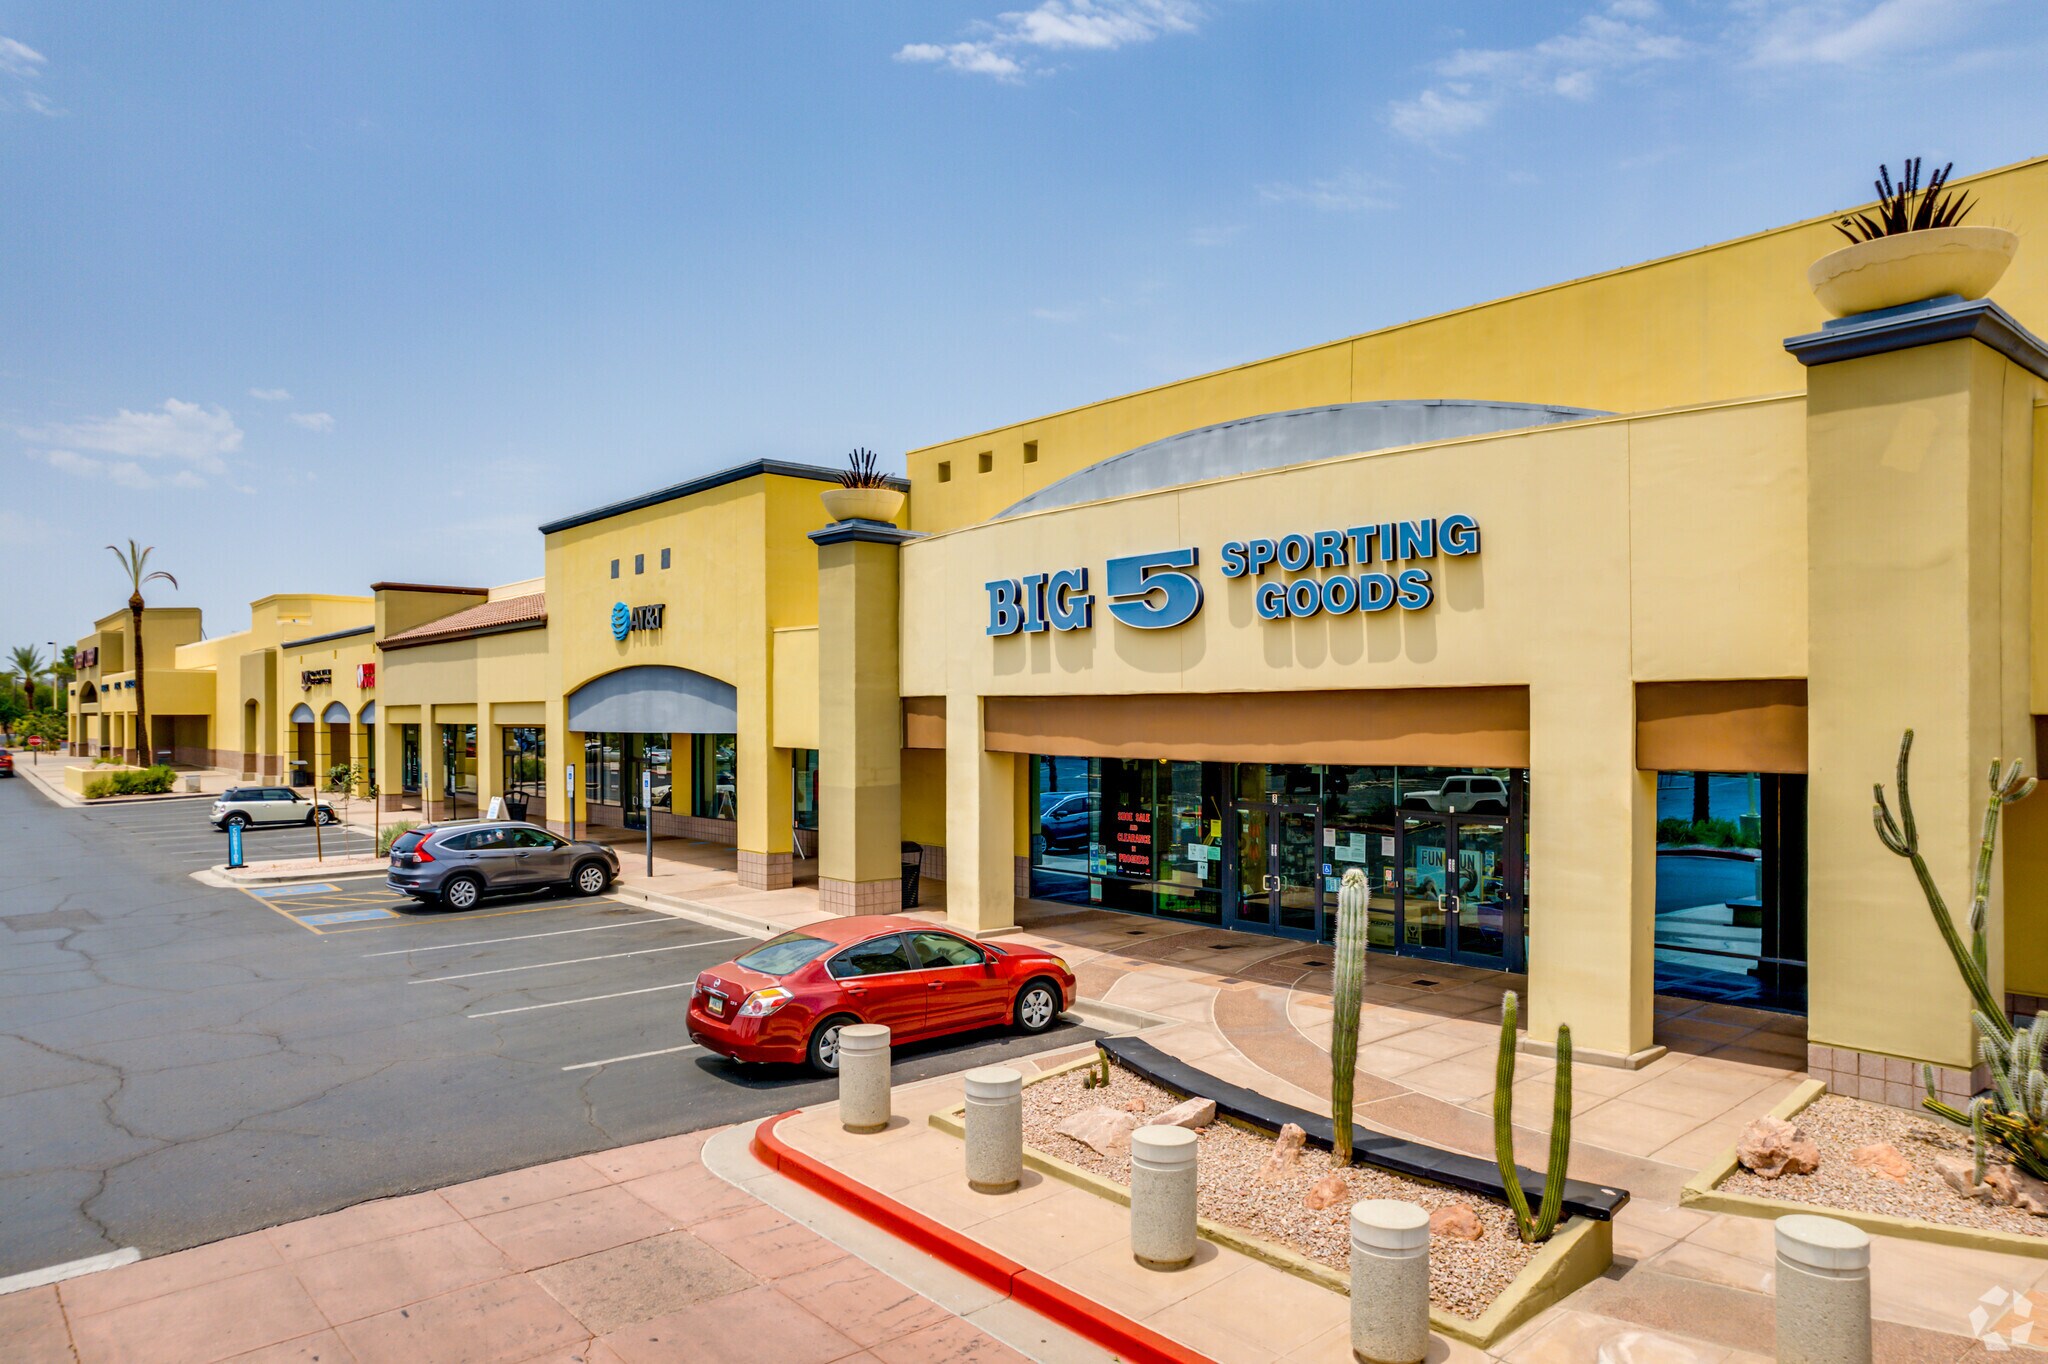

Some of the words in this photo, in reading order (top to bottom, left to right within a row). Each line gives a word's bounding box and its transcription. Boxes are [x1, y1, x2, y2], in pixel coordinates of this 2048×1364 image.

[1221, 514, 1481, 578] SPORTING
[985, 567, 1095, 636] BIG
[1106, 547, 1204, 629] 5
[1256, 568, 1434, 620] GOODS
[630, 604, 665, 631] AT&T
[1117, 812, 1133, 821] SHOE
[1135, 813, 1150, 822] SALE
[1117, 832, 1151, 844] CLEARANCE
[1118, 853, 1149, 865] PROGRESS
[1421, 850, 1443, 866] FUN
[1459, 853, 1475, 869] UN
